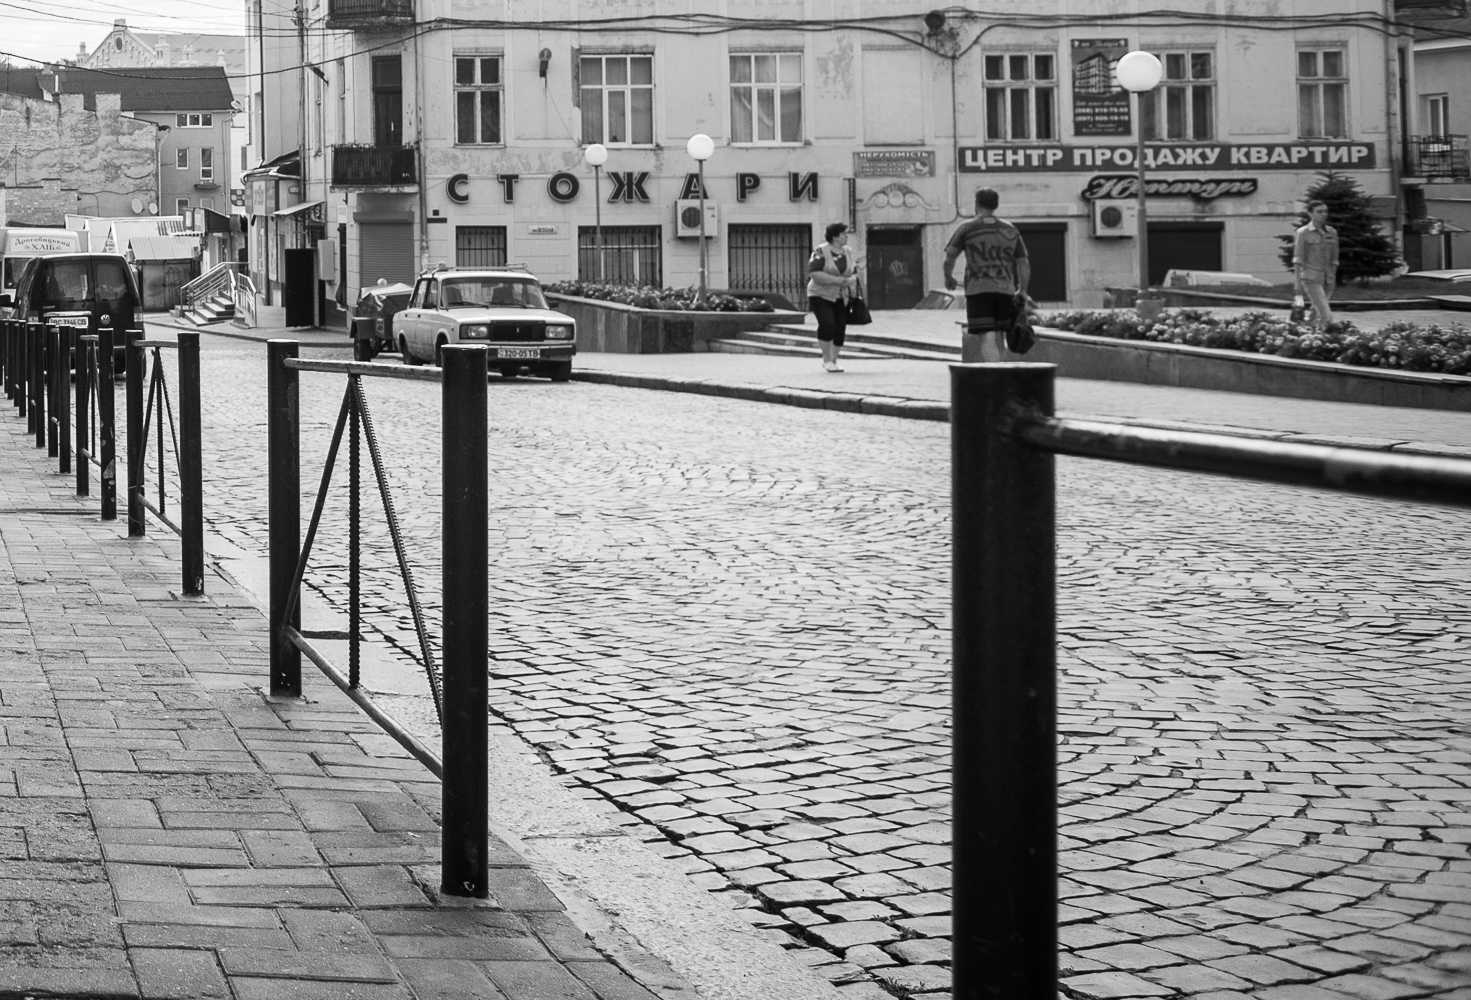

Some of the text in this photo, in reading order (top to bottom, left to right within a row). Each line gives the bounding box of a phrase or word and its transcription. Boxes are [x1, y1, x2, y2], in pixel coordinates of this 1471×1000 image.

[964, 146, 1370, 169] ЦЕНТР ПРОДАЖУ КВАРТИР
[445, 170, 820, 204] СТОЖАРИ
